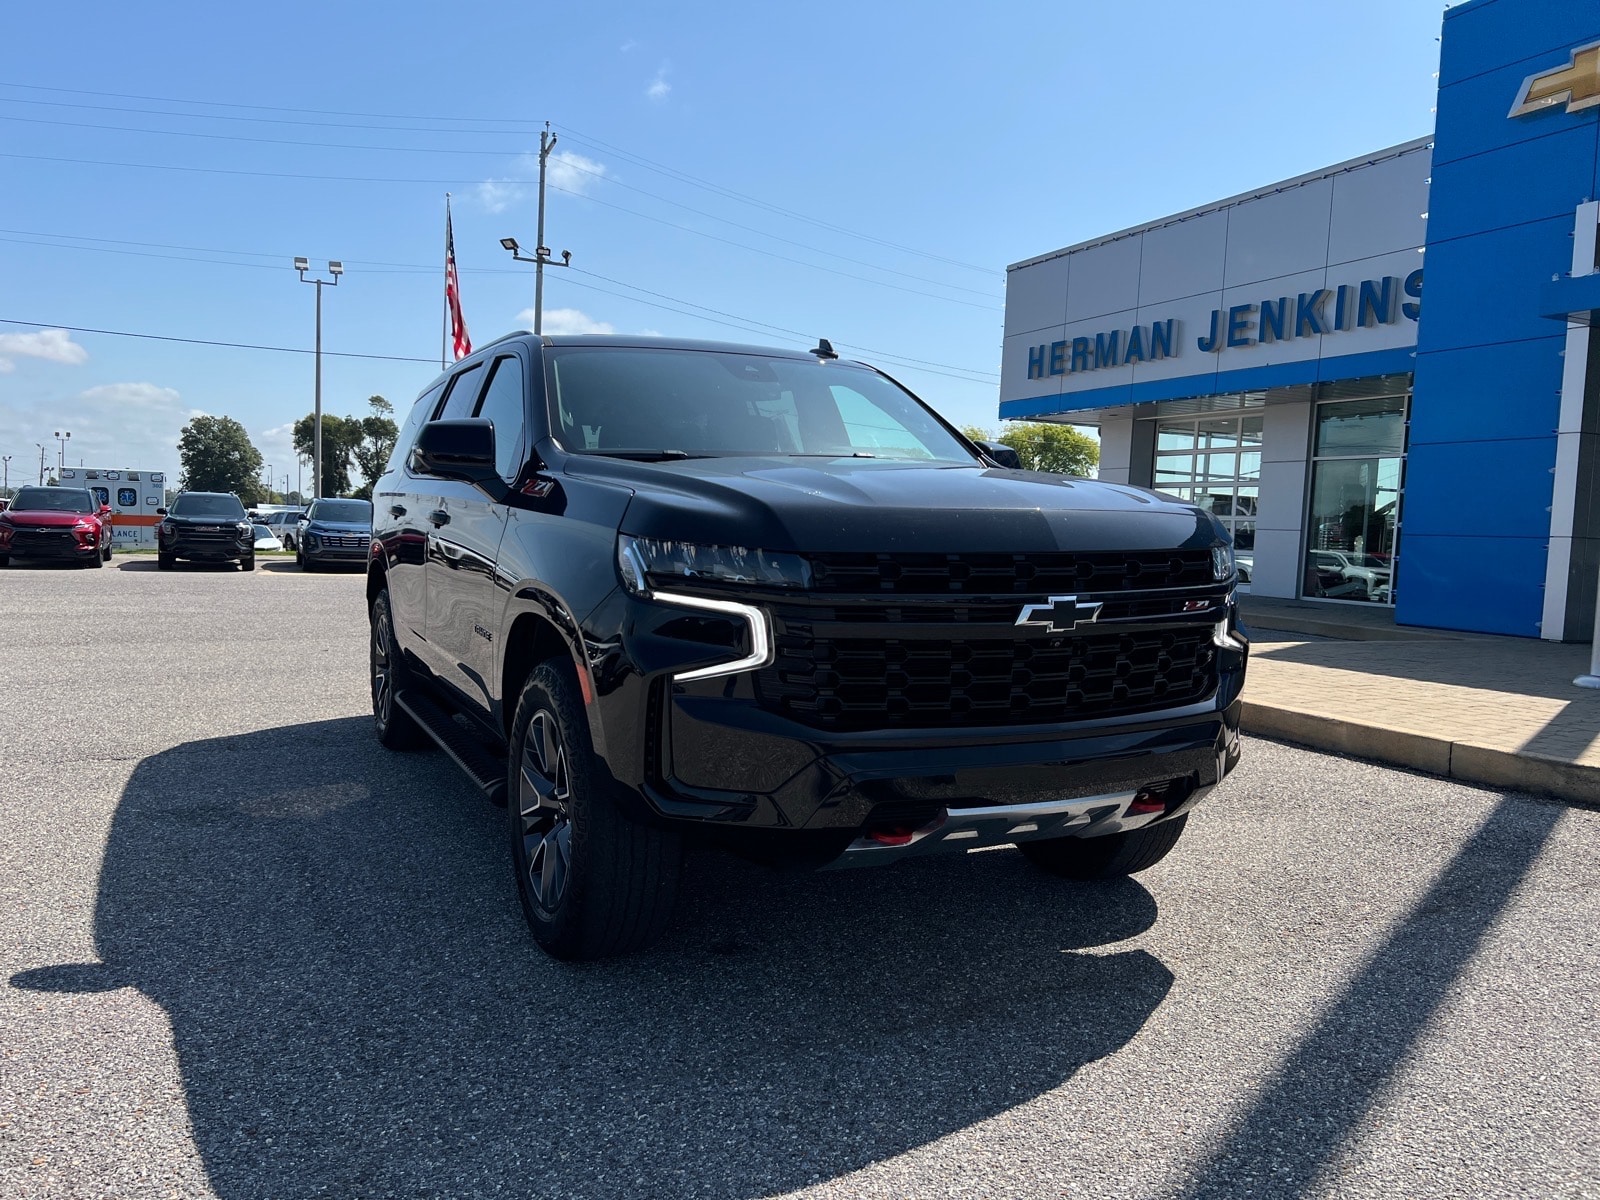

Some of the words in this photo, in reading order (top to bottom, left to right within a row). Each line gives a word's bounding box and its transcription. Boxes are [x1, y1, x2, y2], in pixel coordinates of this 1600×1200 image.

[1027, 318, 1179, 380] HERMAN
[1197, 268, 1423, 352] JENKINS
[520, 478, 555, 498] Z71
[112, 530, 138, 538] LANCE
[1183, 600, 1210, 611] Z71
